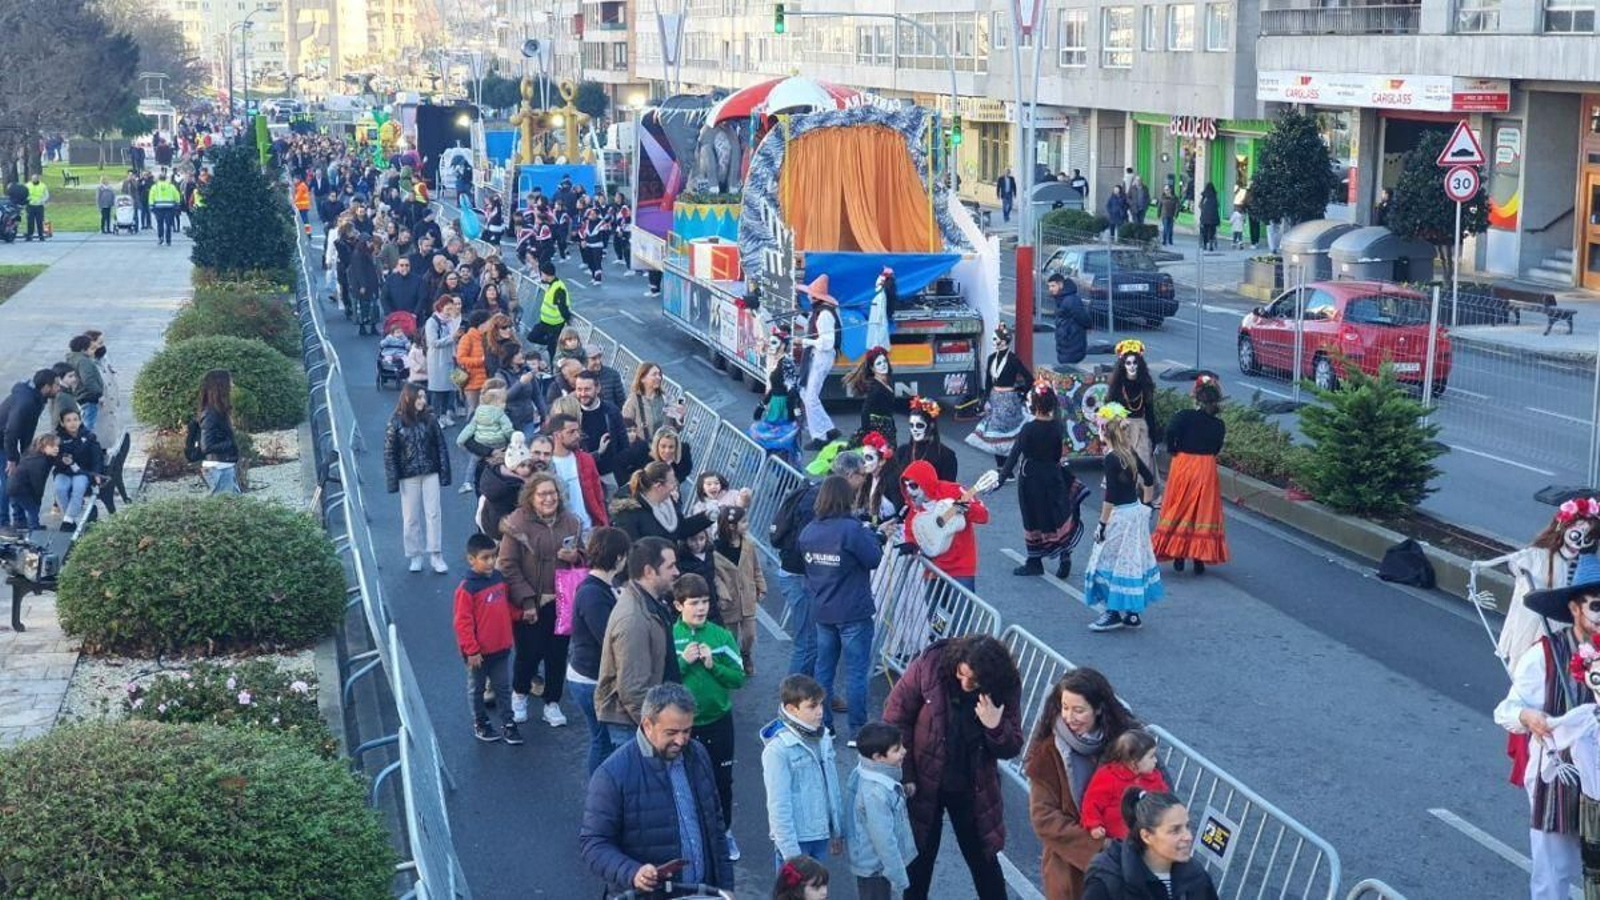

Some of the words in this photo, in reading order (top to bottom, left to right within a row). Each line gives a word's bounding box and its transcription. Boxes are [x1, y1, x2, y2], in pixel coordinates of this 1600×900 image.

[1285, 88, 1320, 99] CARGLASS
[1371, 92, 1413, 105] CARGLASS
[1452, 177, 1472, 190] 30
